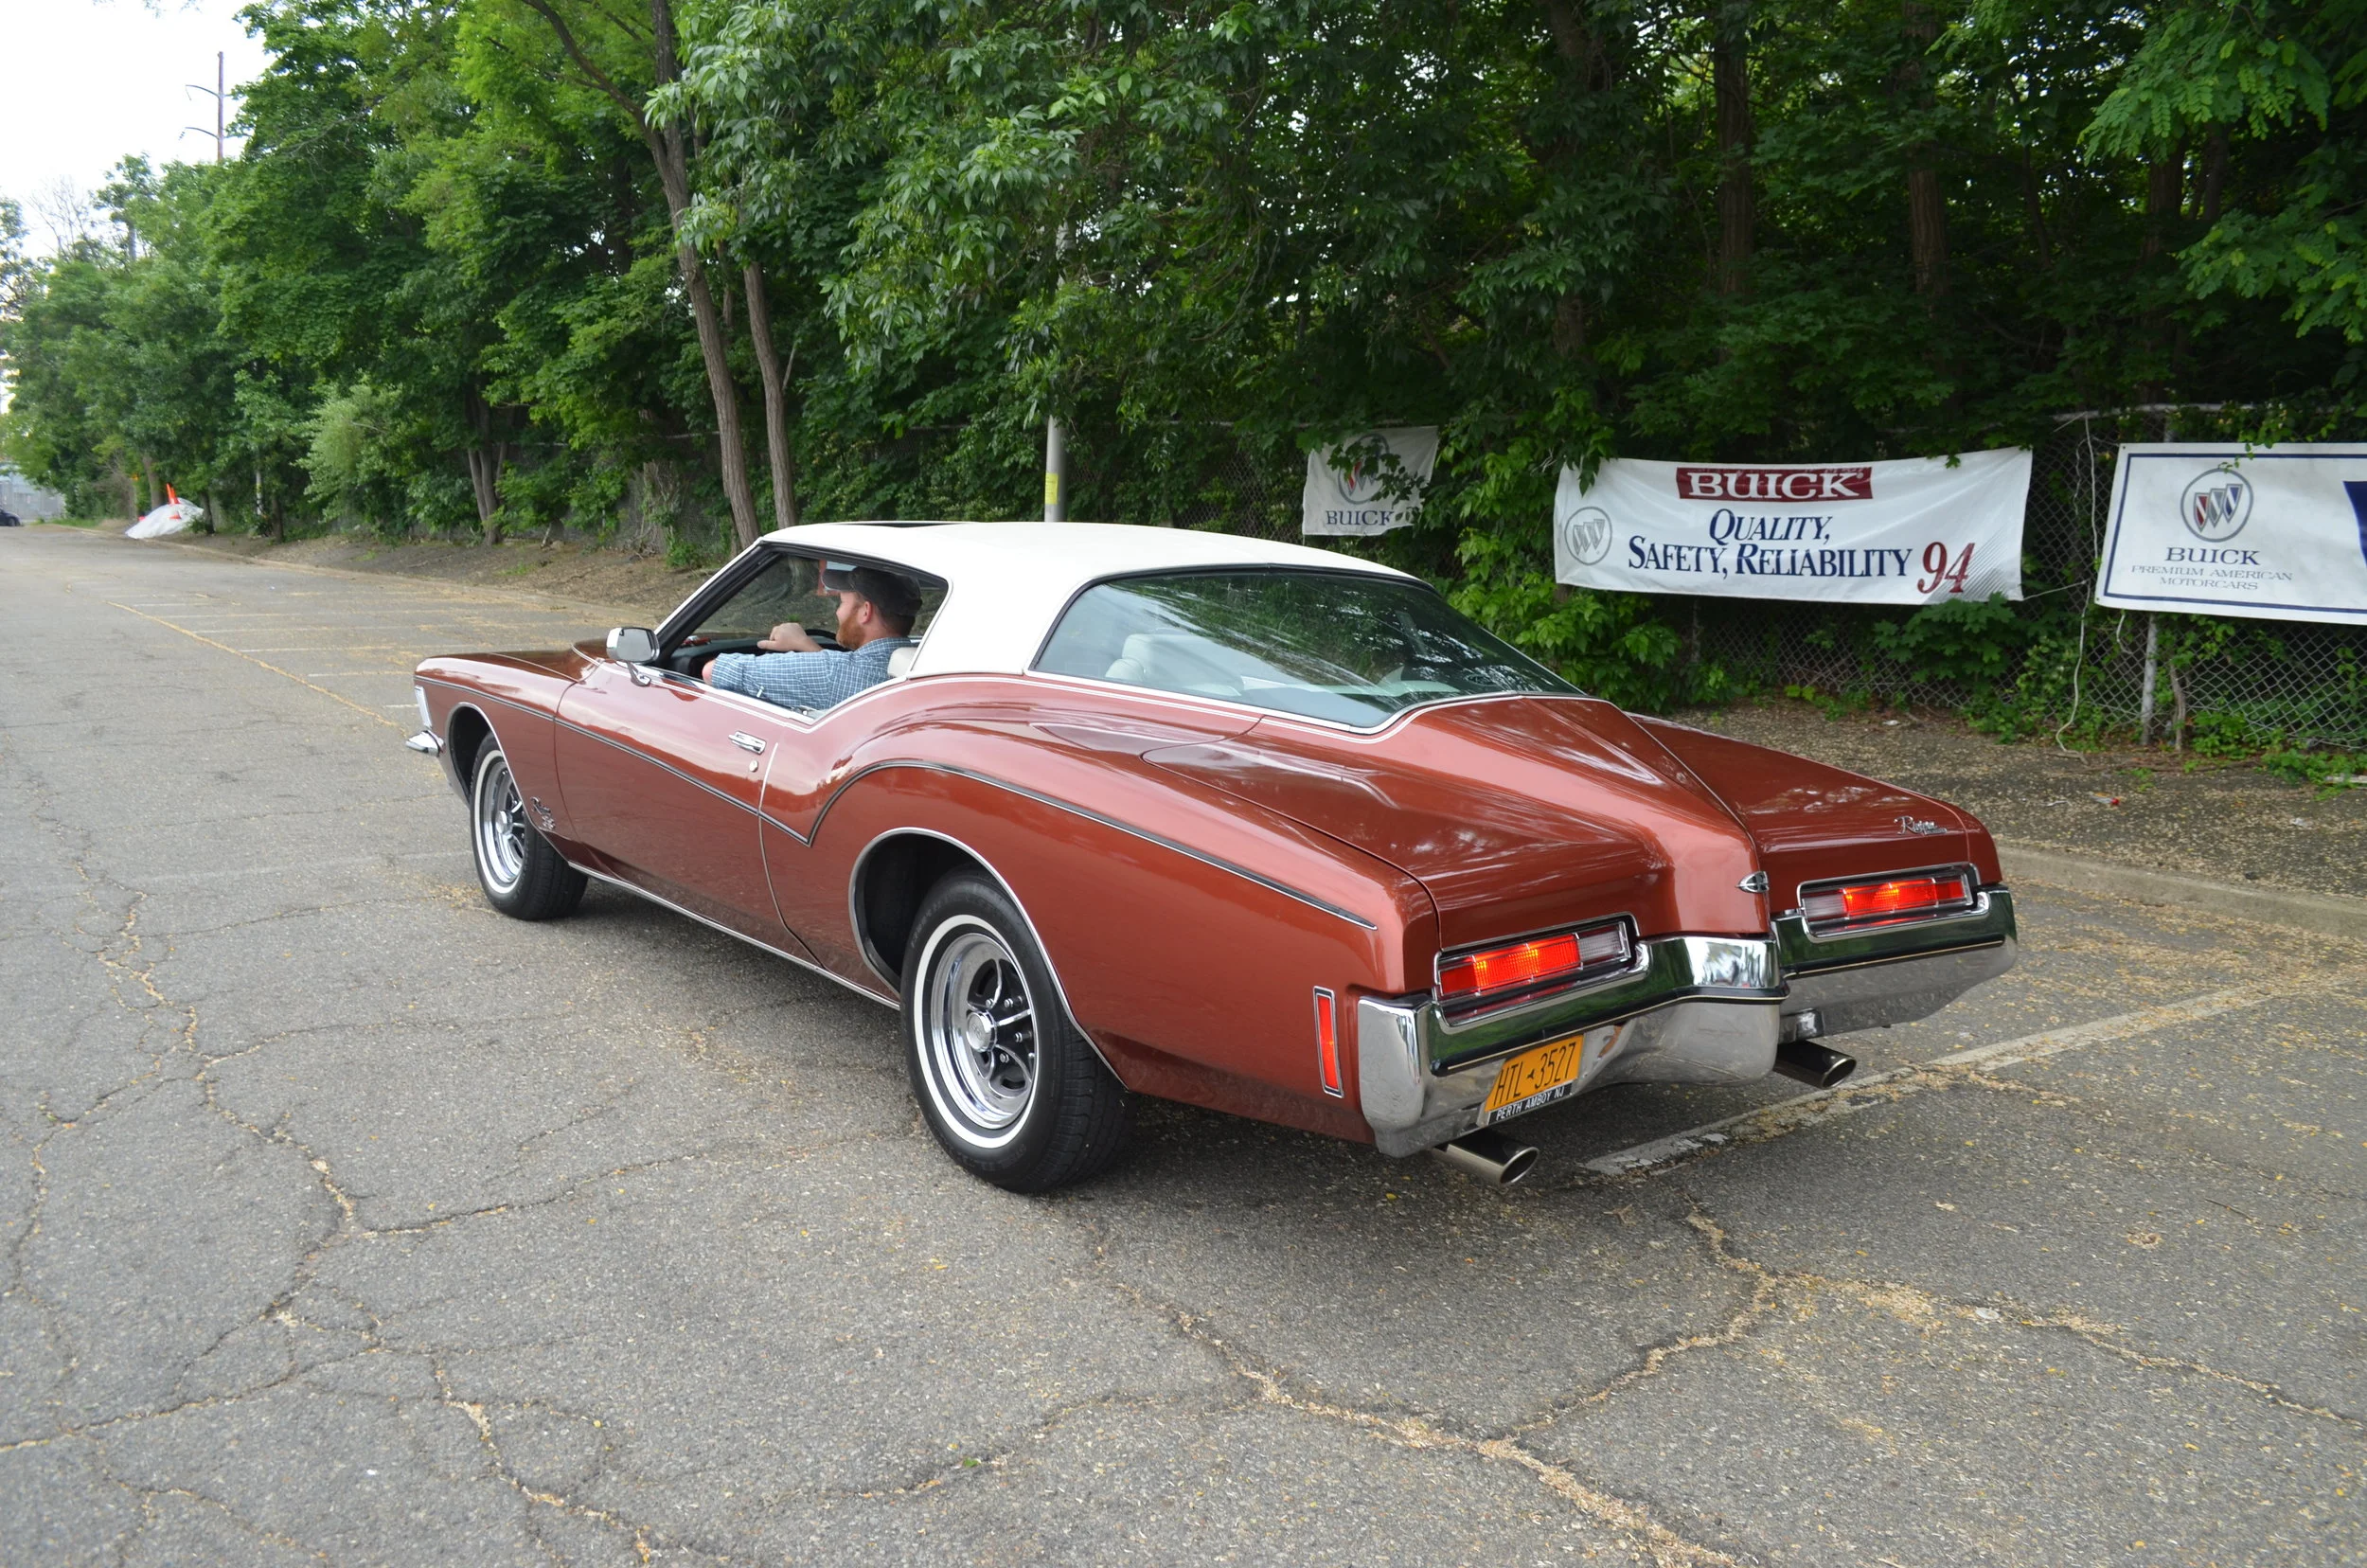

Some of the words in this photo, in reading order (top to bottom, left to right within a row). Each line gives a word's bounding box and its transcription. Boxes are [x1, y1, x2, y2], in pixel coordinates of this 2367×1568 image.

[1687, 472, 1860, 499] BUICK
[1326, 509, 1394, 526] BUICK
[1709, 508, 1832, 545] QUALITY,
[1628, 535, 1728, 579] SAFETY,
[1735, 543, 1913, 577] RELIABILITY
[1916, 542, 1975, 594] 94
[2164, 546, 2261, 566] BUICK
[2130, 564, 2204, 577] PREMIUM
[2209, 568, 2293, 581] AMERICAN
[2159, 577, 2258, 591] MOTORCARS
[1496, 1102, 1522, 1121] PERTH
[1524, 1092, 1551, 1110] AMBOY
[1554, 1086, 1565, 1098] NJ
